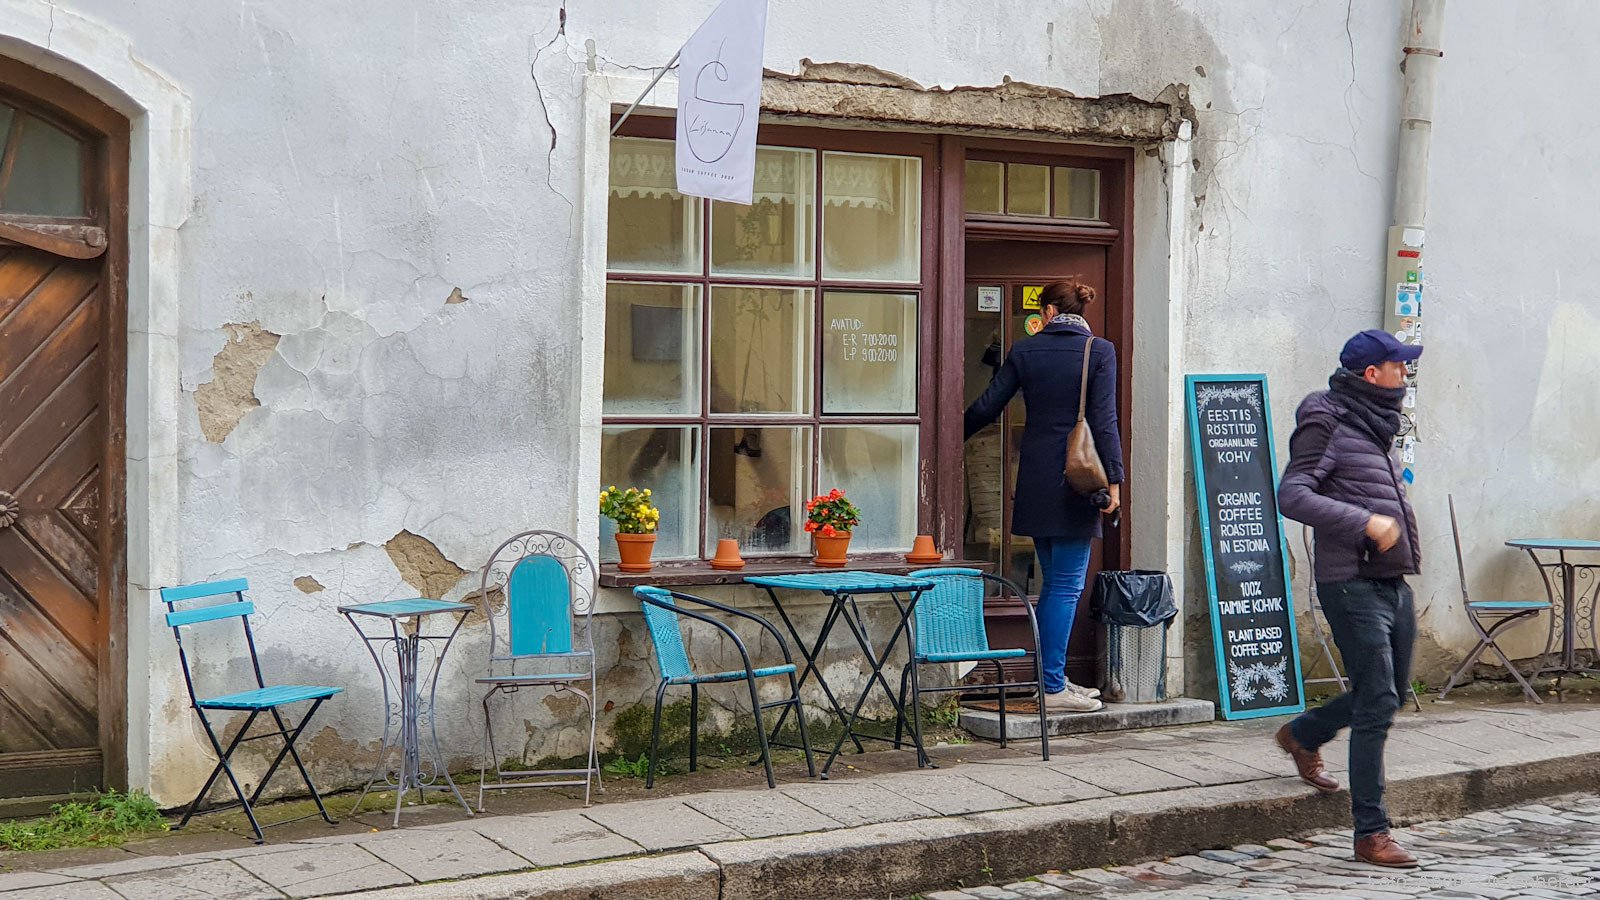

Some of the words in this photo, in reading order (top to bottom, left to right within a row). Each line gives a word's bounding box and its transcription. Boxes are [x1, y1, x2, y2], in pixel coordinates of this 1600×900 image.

[830, 318, 864, 331] AVATUD:
[843, 333, 857, 346] E-R
[843, 347, 857, 361] L-P
[1207, 409, 1252, 422] EESTIS
[1206, 423, 1257, 436] RÖSTITUD
[1208, 438, 1259, 448] ORGAANILINE
[1217, 450, 1252, 463] KOHV
[1217, 492, 1262, 506] ORGANIC
[1218, 508, 1263, 522] COFFEE
[1220, 523, 1264, 537] ROASTED
[1220, 540, 1231, 554] IN
[1240, 581, 1262, 597] 100%
[1252, 597, 1284, 613] KOHVIK
[1228, 629, 1254, 643] PLANT
[1255, 626, 1283, 640] BASED
[1231, 643, 1260, 657] COFFEE
[1260, 641, 1283, 655] SHOP
